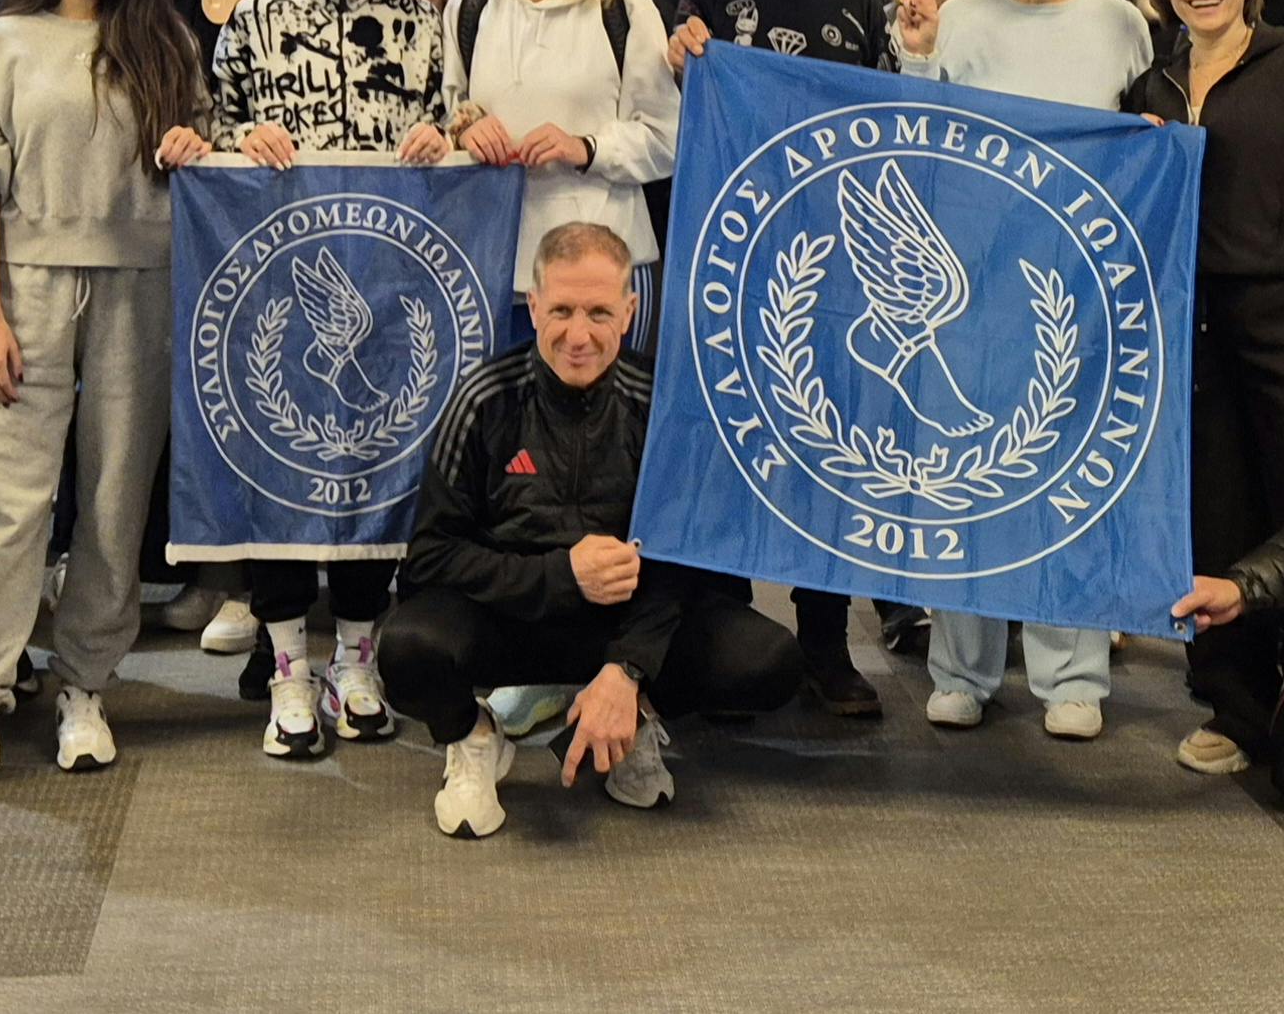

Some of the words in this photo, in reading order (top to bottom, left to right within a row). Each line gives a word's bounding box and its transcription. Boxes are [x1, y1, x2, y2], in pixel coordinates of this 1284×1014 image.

[196, 258, 252, 443] ΣΥΛΛΟΓΟΣ
[252, 202, 417, 264] ΔΡΟΜΕΩΝ
[414, 230, 485, 378] ΙΩΑΝΝΙΝ
[704, 179, 789, 483] ΣΥΛΛΟΓΟΣ
[785, 113, 1057, 190] ΔΡΟΜΕΩΝ
[1045, 189, 1154, 525] ΙΩΑΝΝΙΝΩΝ
[306, 476, 372, 505] 2012
[842, 513, 966, 561] 2012
